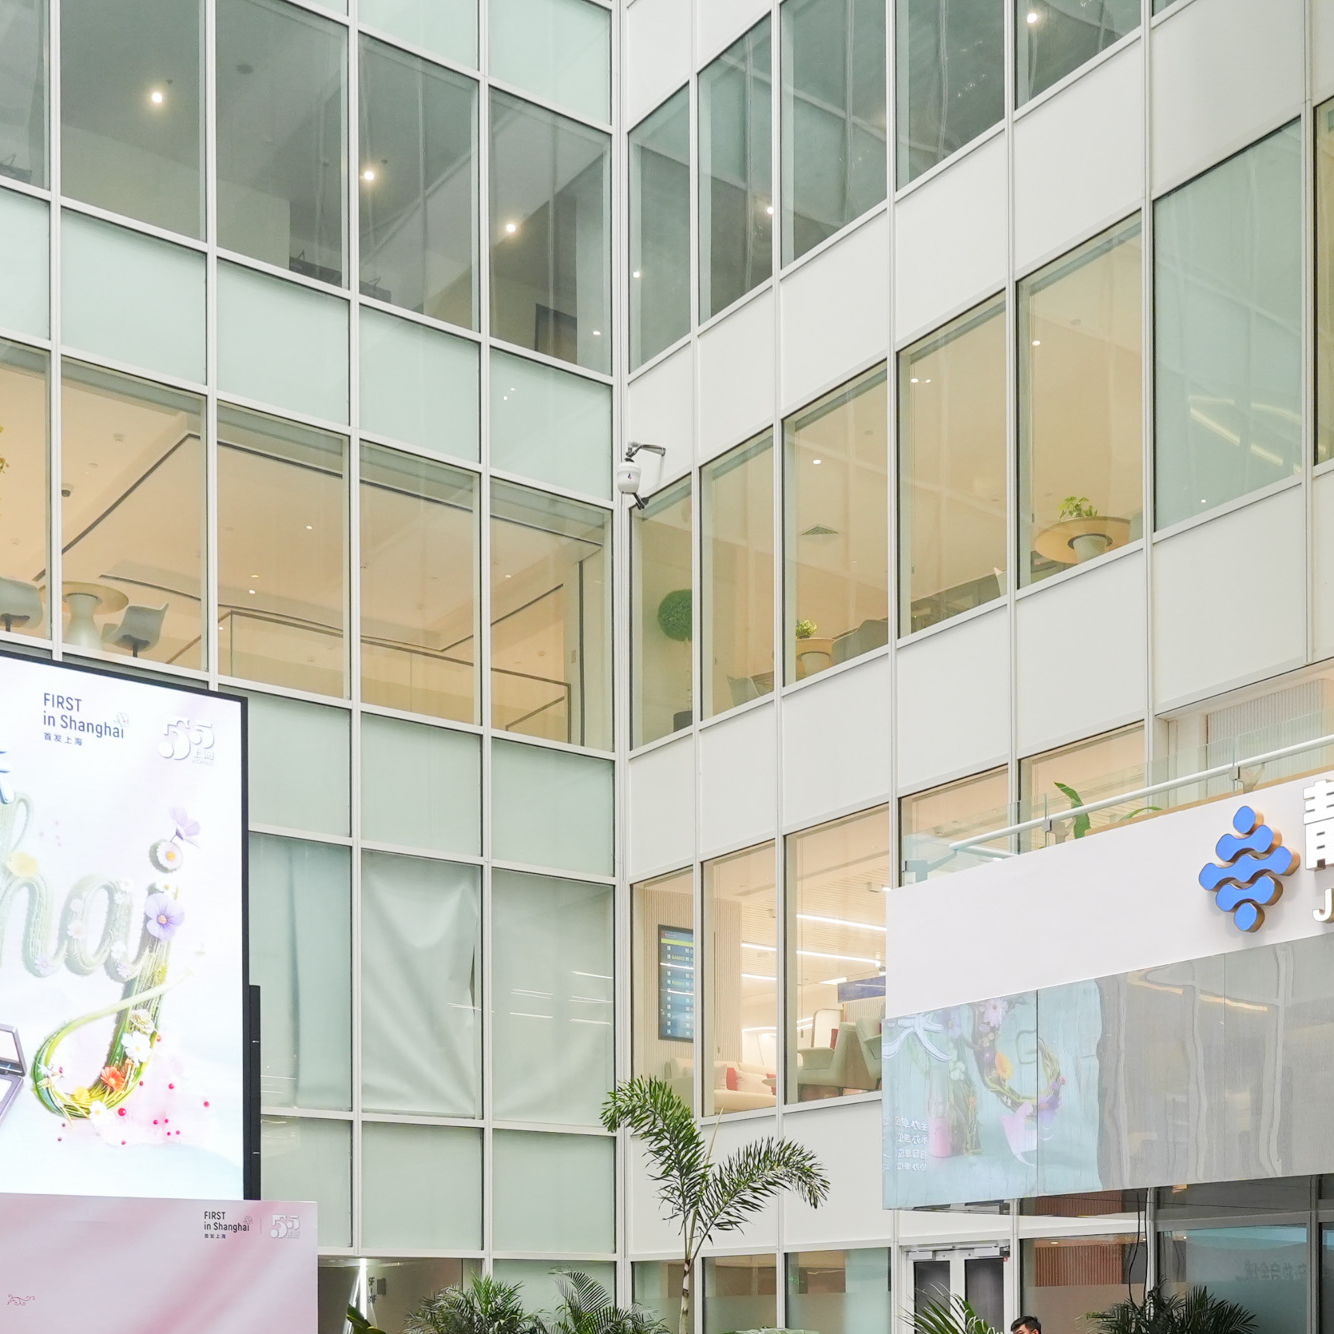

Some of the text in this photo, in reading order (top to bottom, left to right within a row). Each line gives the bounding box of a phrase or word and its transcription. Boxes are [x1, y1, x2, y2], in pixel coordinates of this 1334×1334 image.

[43, 692, 83, 713] FIRST
[43, 710, 125, 739] in Shanghai
[44, 732, 83, 747] 首发上海
[204, 1211, 226, 1220] FIRST
[204, 1221, 250, 1233] in Shanghai
